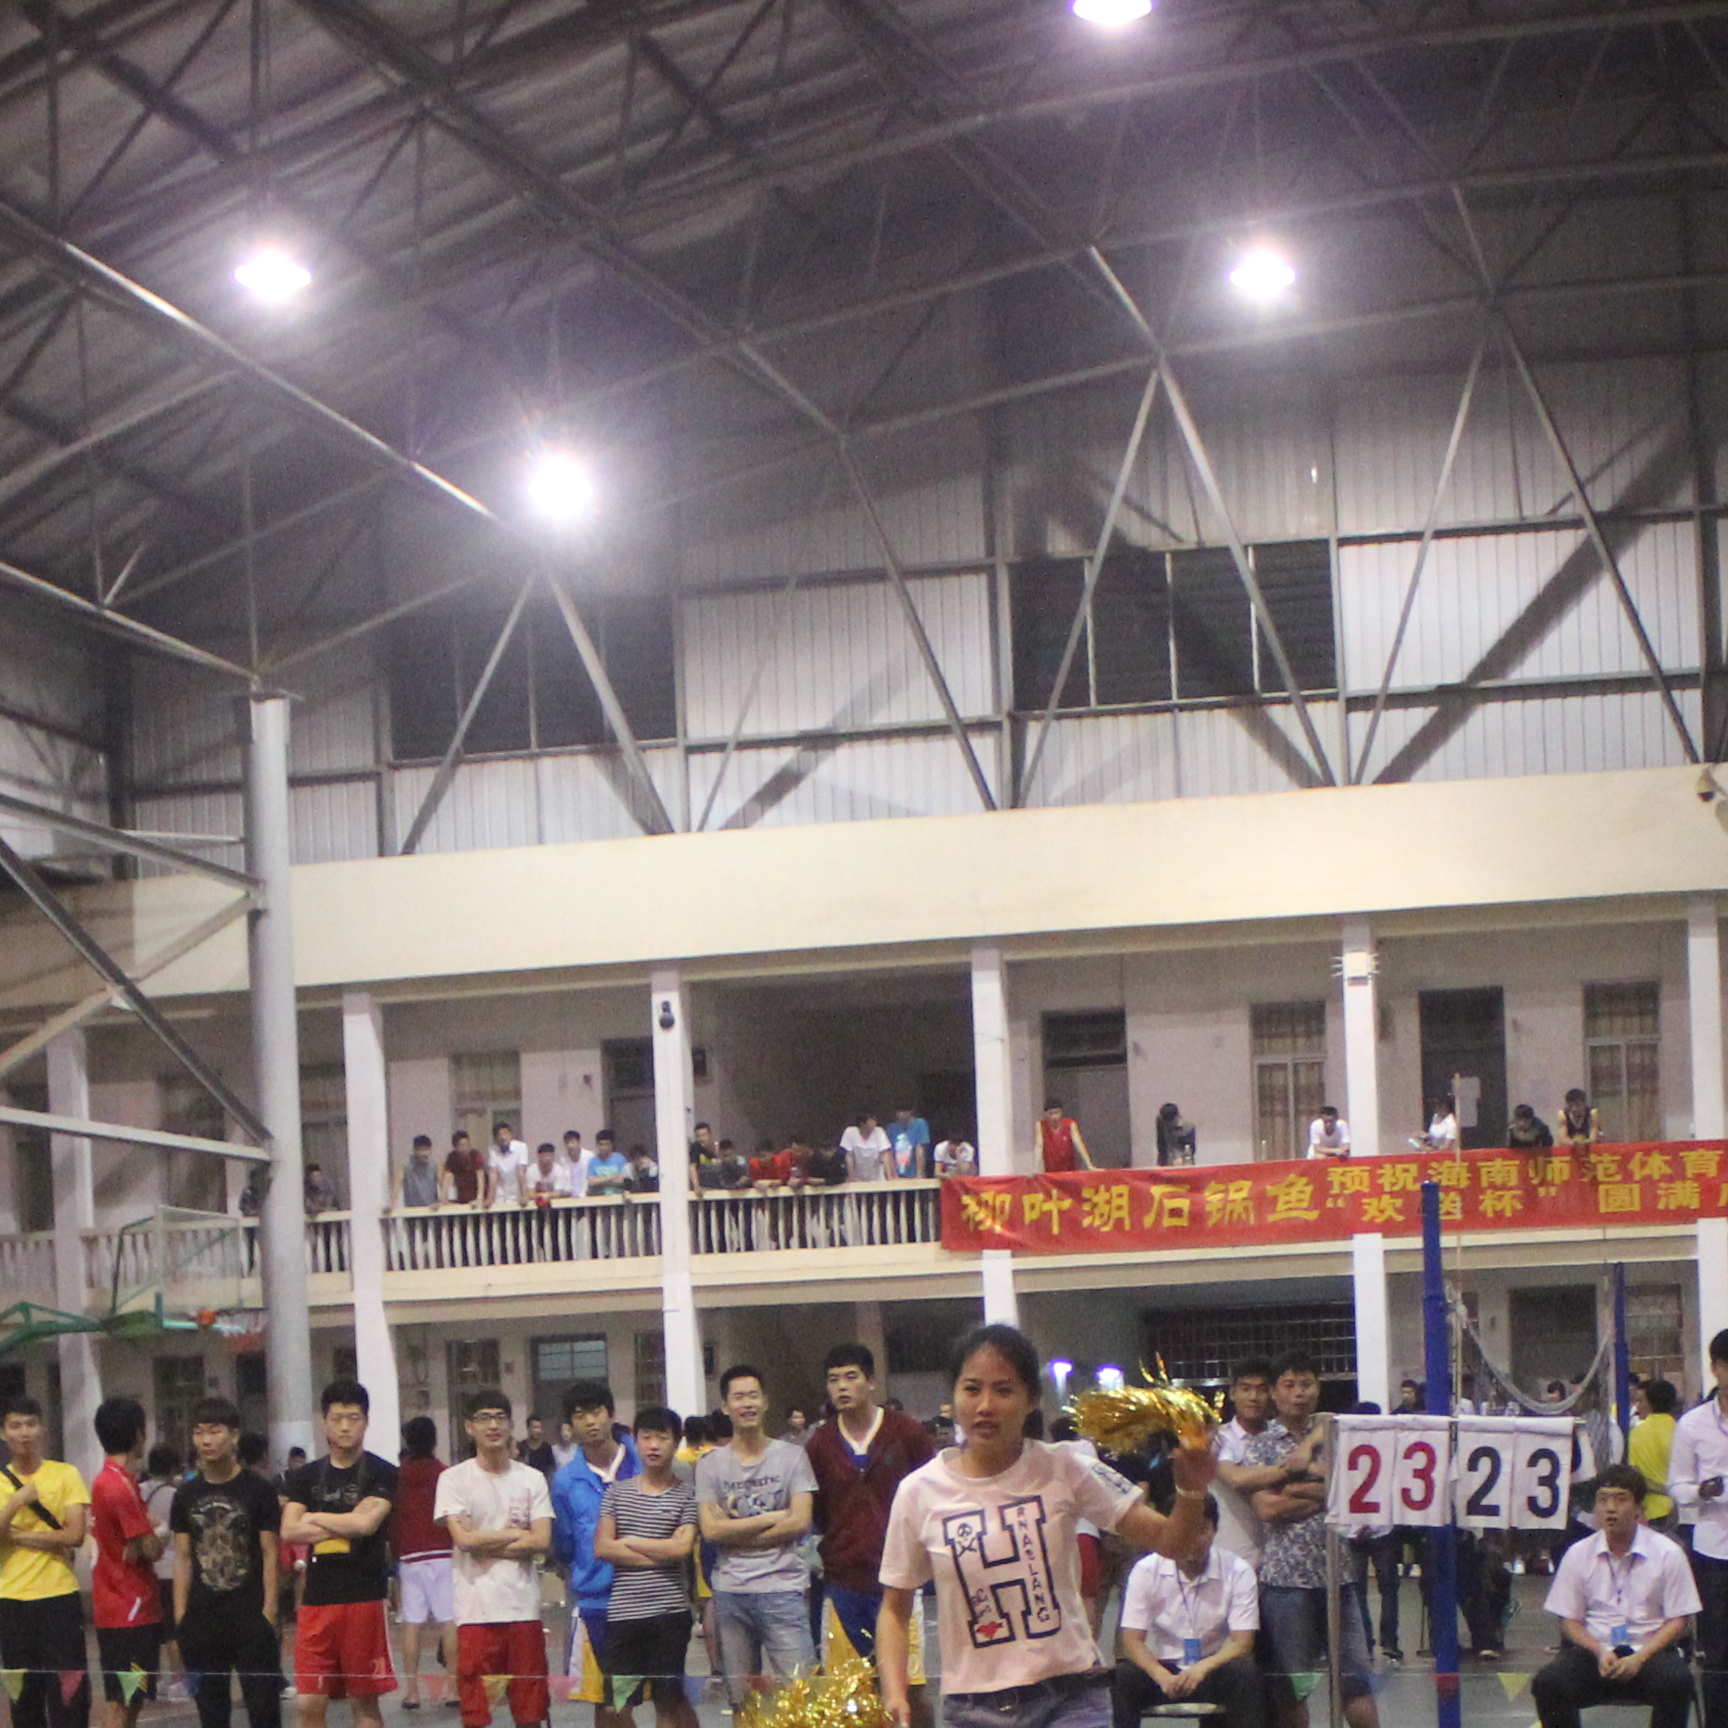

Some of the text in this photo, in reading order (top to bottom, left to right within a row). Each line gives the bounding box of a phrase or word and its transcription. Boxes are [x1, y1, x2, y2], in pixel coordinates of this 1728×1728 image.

[960, 1173, 1319, 1235] 柳叶湖石锅鱼
[1347, 1441, 1561, 1518] 23 23
